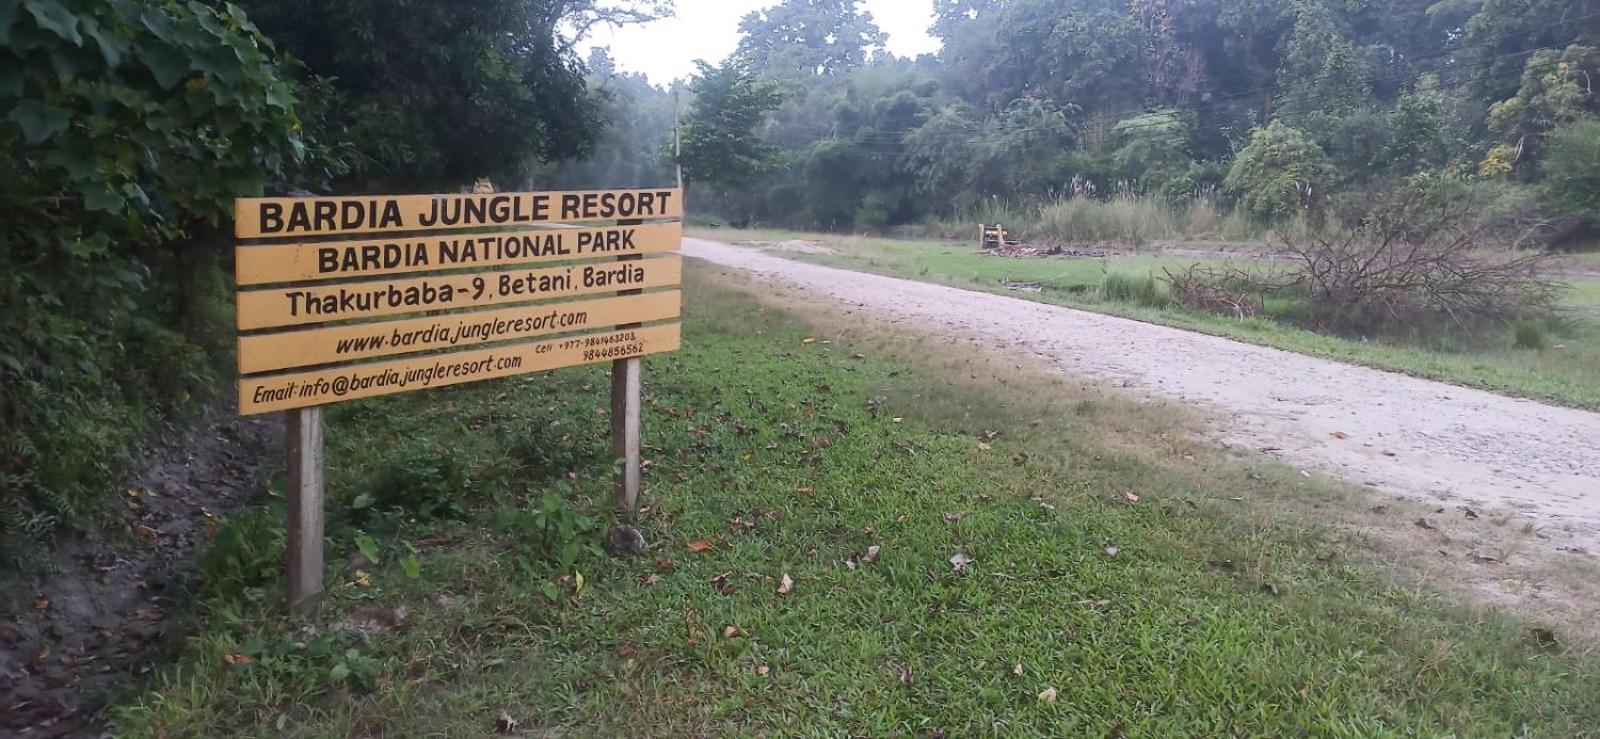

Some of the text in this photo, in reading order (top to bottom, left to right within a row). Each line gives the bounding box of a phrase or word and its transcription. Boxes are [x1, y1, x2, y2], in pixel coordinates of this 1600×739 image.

[259, 191, 672, 233] BARDIA JUNGLE RESORT
[318, 229, 636, 273] BARDIA NATIONAL PARK
[583, 264, 645, 288] Bardia
[535, 343, 553, 354] Cell
[583, 342, 644, 361] 9844856562
